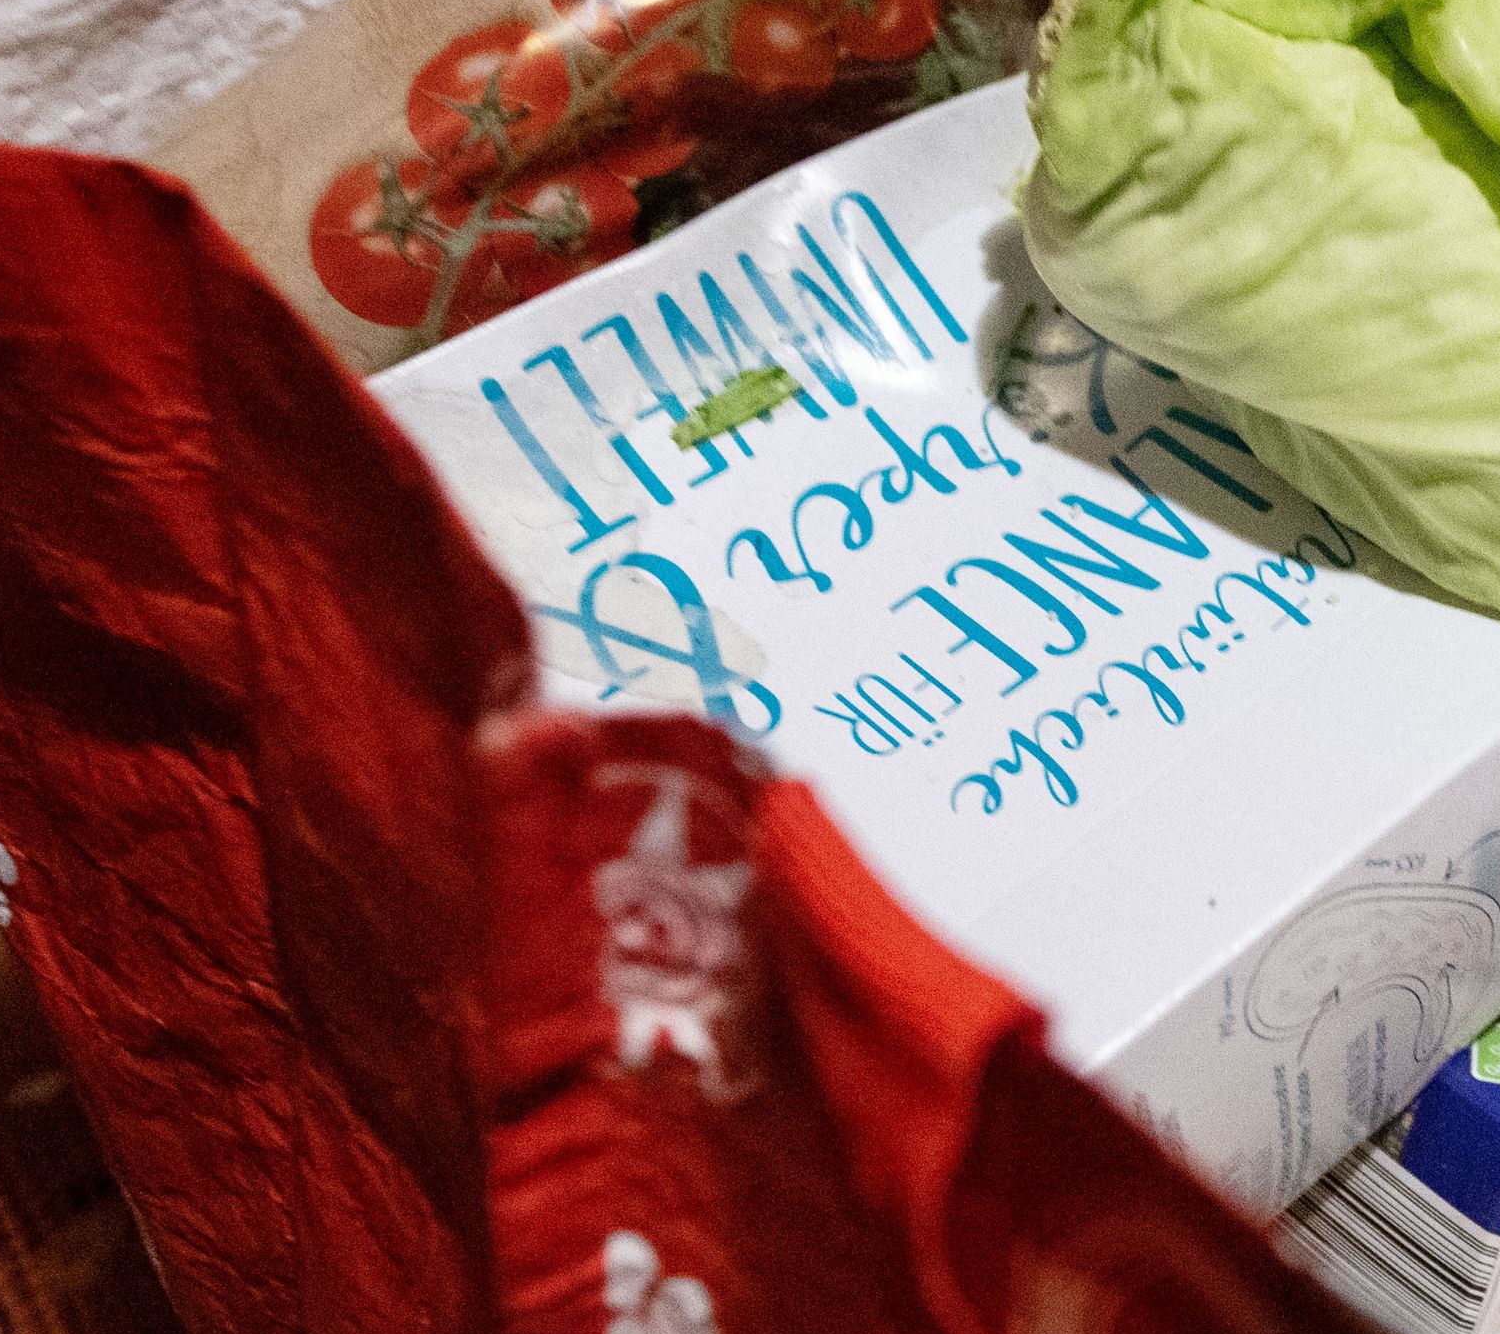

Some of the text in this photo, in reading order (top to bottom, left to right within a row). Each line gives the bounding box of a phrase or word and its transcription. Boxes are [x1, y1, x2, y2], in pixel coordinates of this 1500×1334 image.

[480, 190, 969, 554] UMWELT
[528, 551, 783, 735] &
[813, 405, 1275, 757] LANCE FÜR
[950, 503, 1357, 815] natürliche
